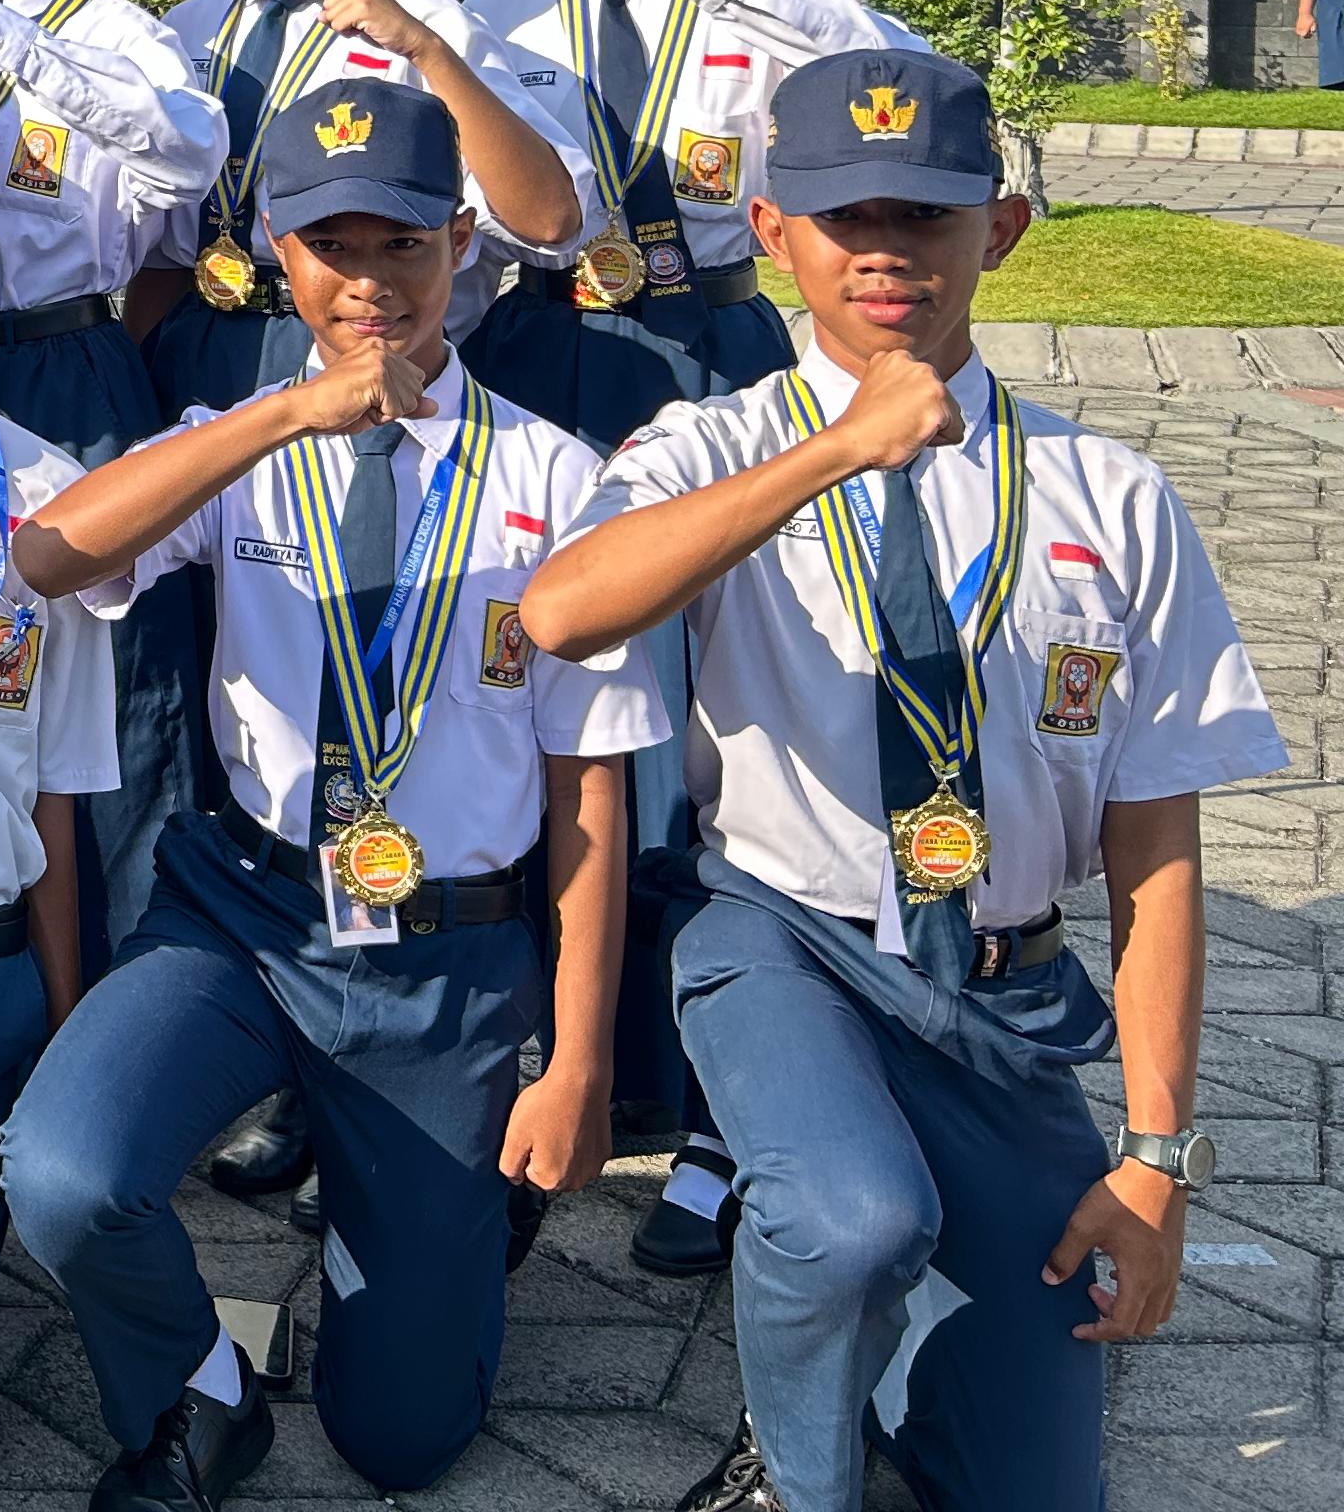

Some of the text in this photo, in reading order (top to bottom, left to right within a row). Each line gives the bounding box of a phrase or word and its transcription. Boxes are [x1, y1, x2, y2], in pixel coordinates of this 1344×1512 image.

[18, 176, 46, 188] OSIS
[851, 488, 872, 518] HANG
[862, 518, 881, 548] TUAH
[253, 544, 292, 561] RADITYA
[295, 551, 307, 564] PU
[383, 607, 400, 630] SMP
[394, 578, 411, 607] HANG
[403, 550, 422, 578] TUAH
[415, 488, 442, 544] EXCELLENT
[1057, 718, 1089, 730] OSIS
